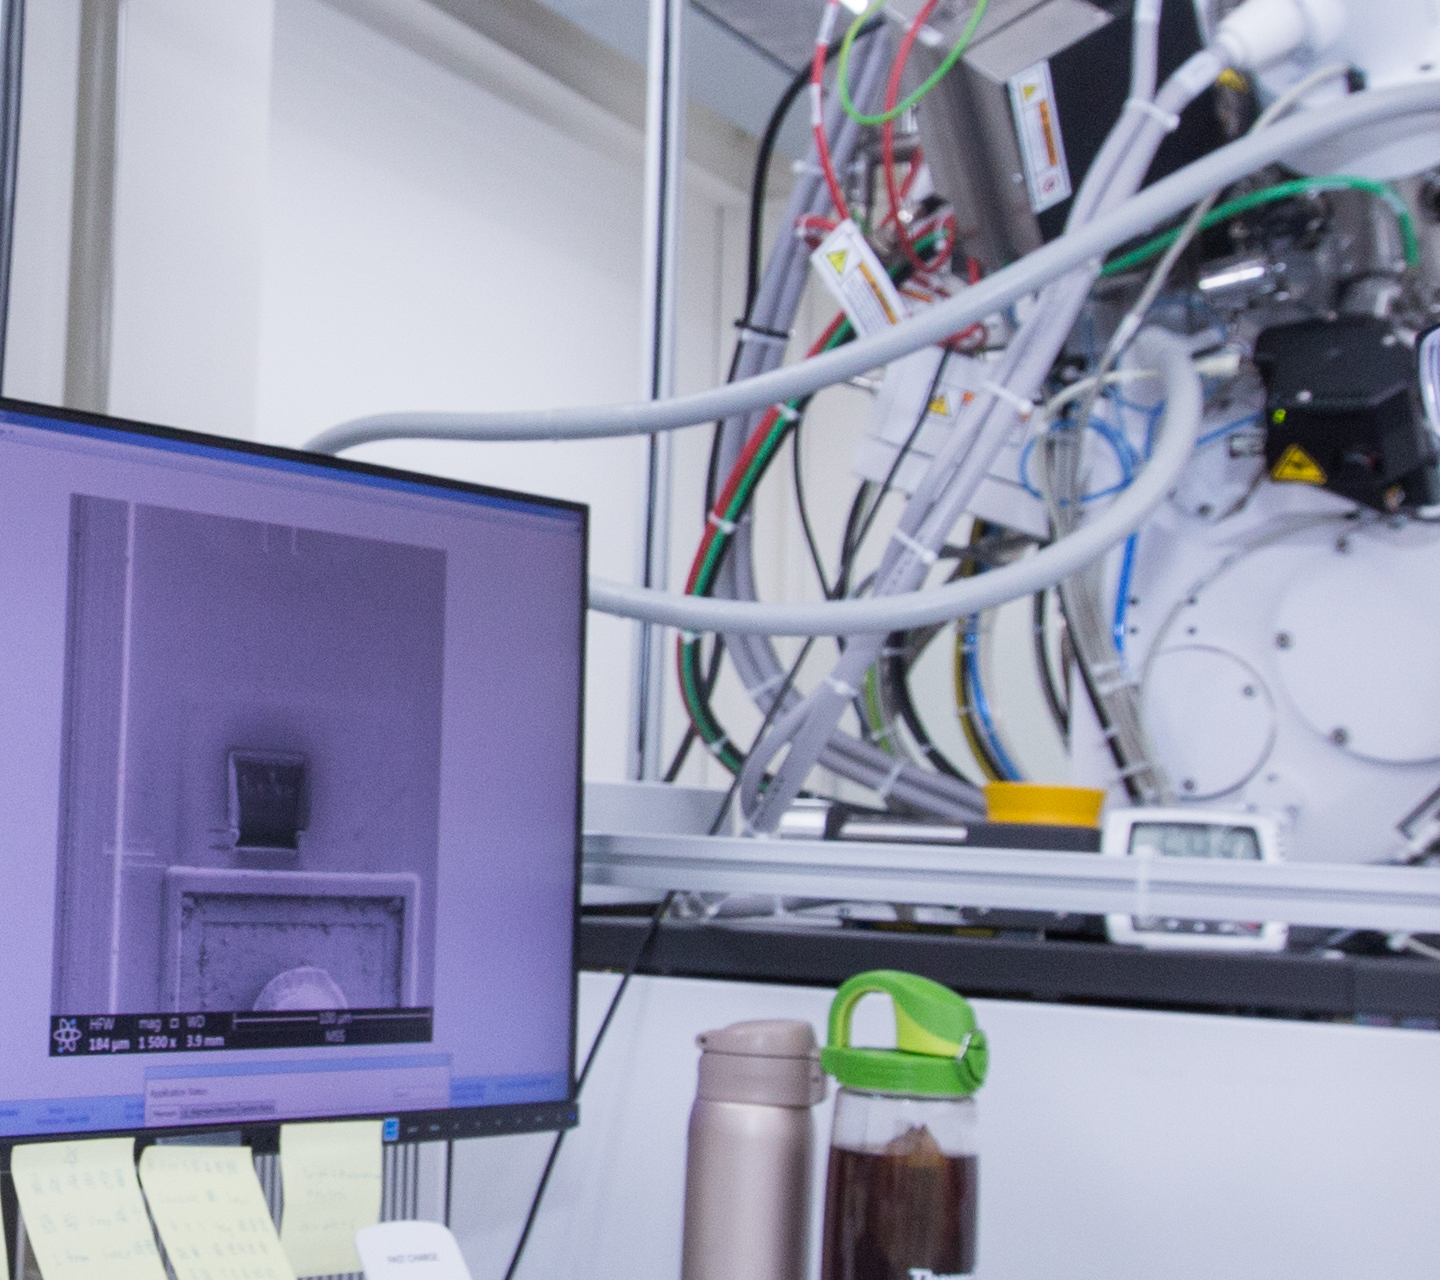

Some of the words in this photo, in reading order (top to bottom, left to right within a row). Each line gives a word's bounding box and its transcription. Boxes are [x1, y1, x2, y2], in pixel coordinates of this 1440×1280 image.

[138, 1018, 161, 1032] mag
[88, 1037, 110, 1052] 184
[186, 1035, 202, 1048] 3.9
[203, 1036, 225, 1047] mm
